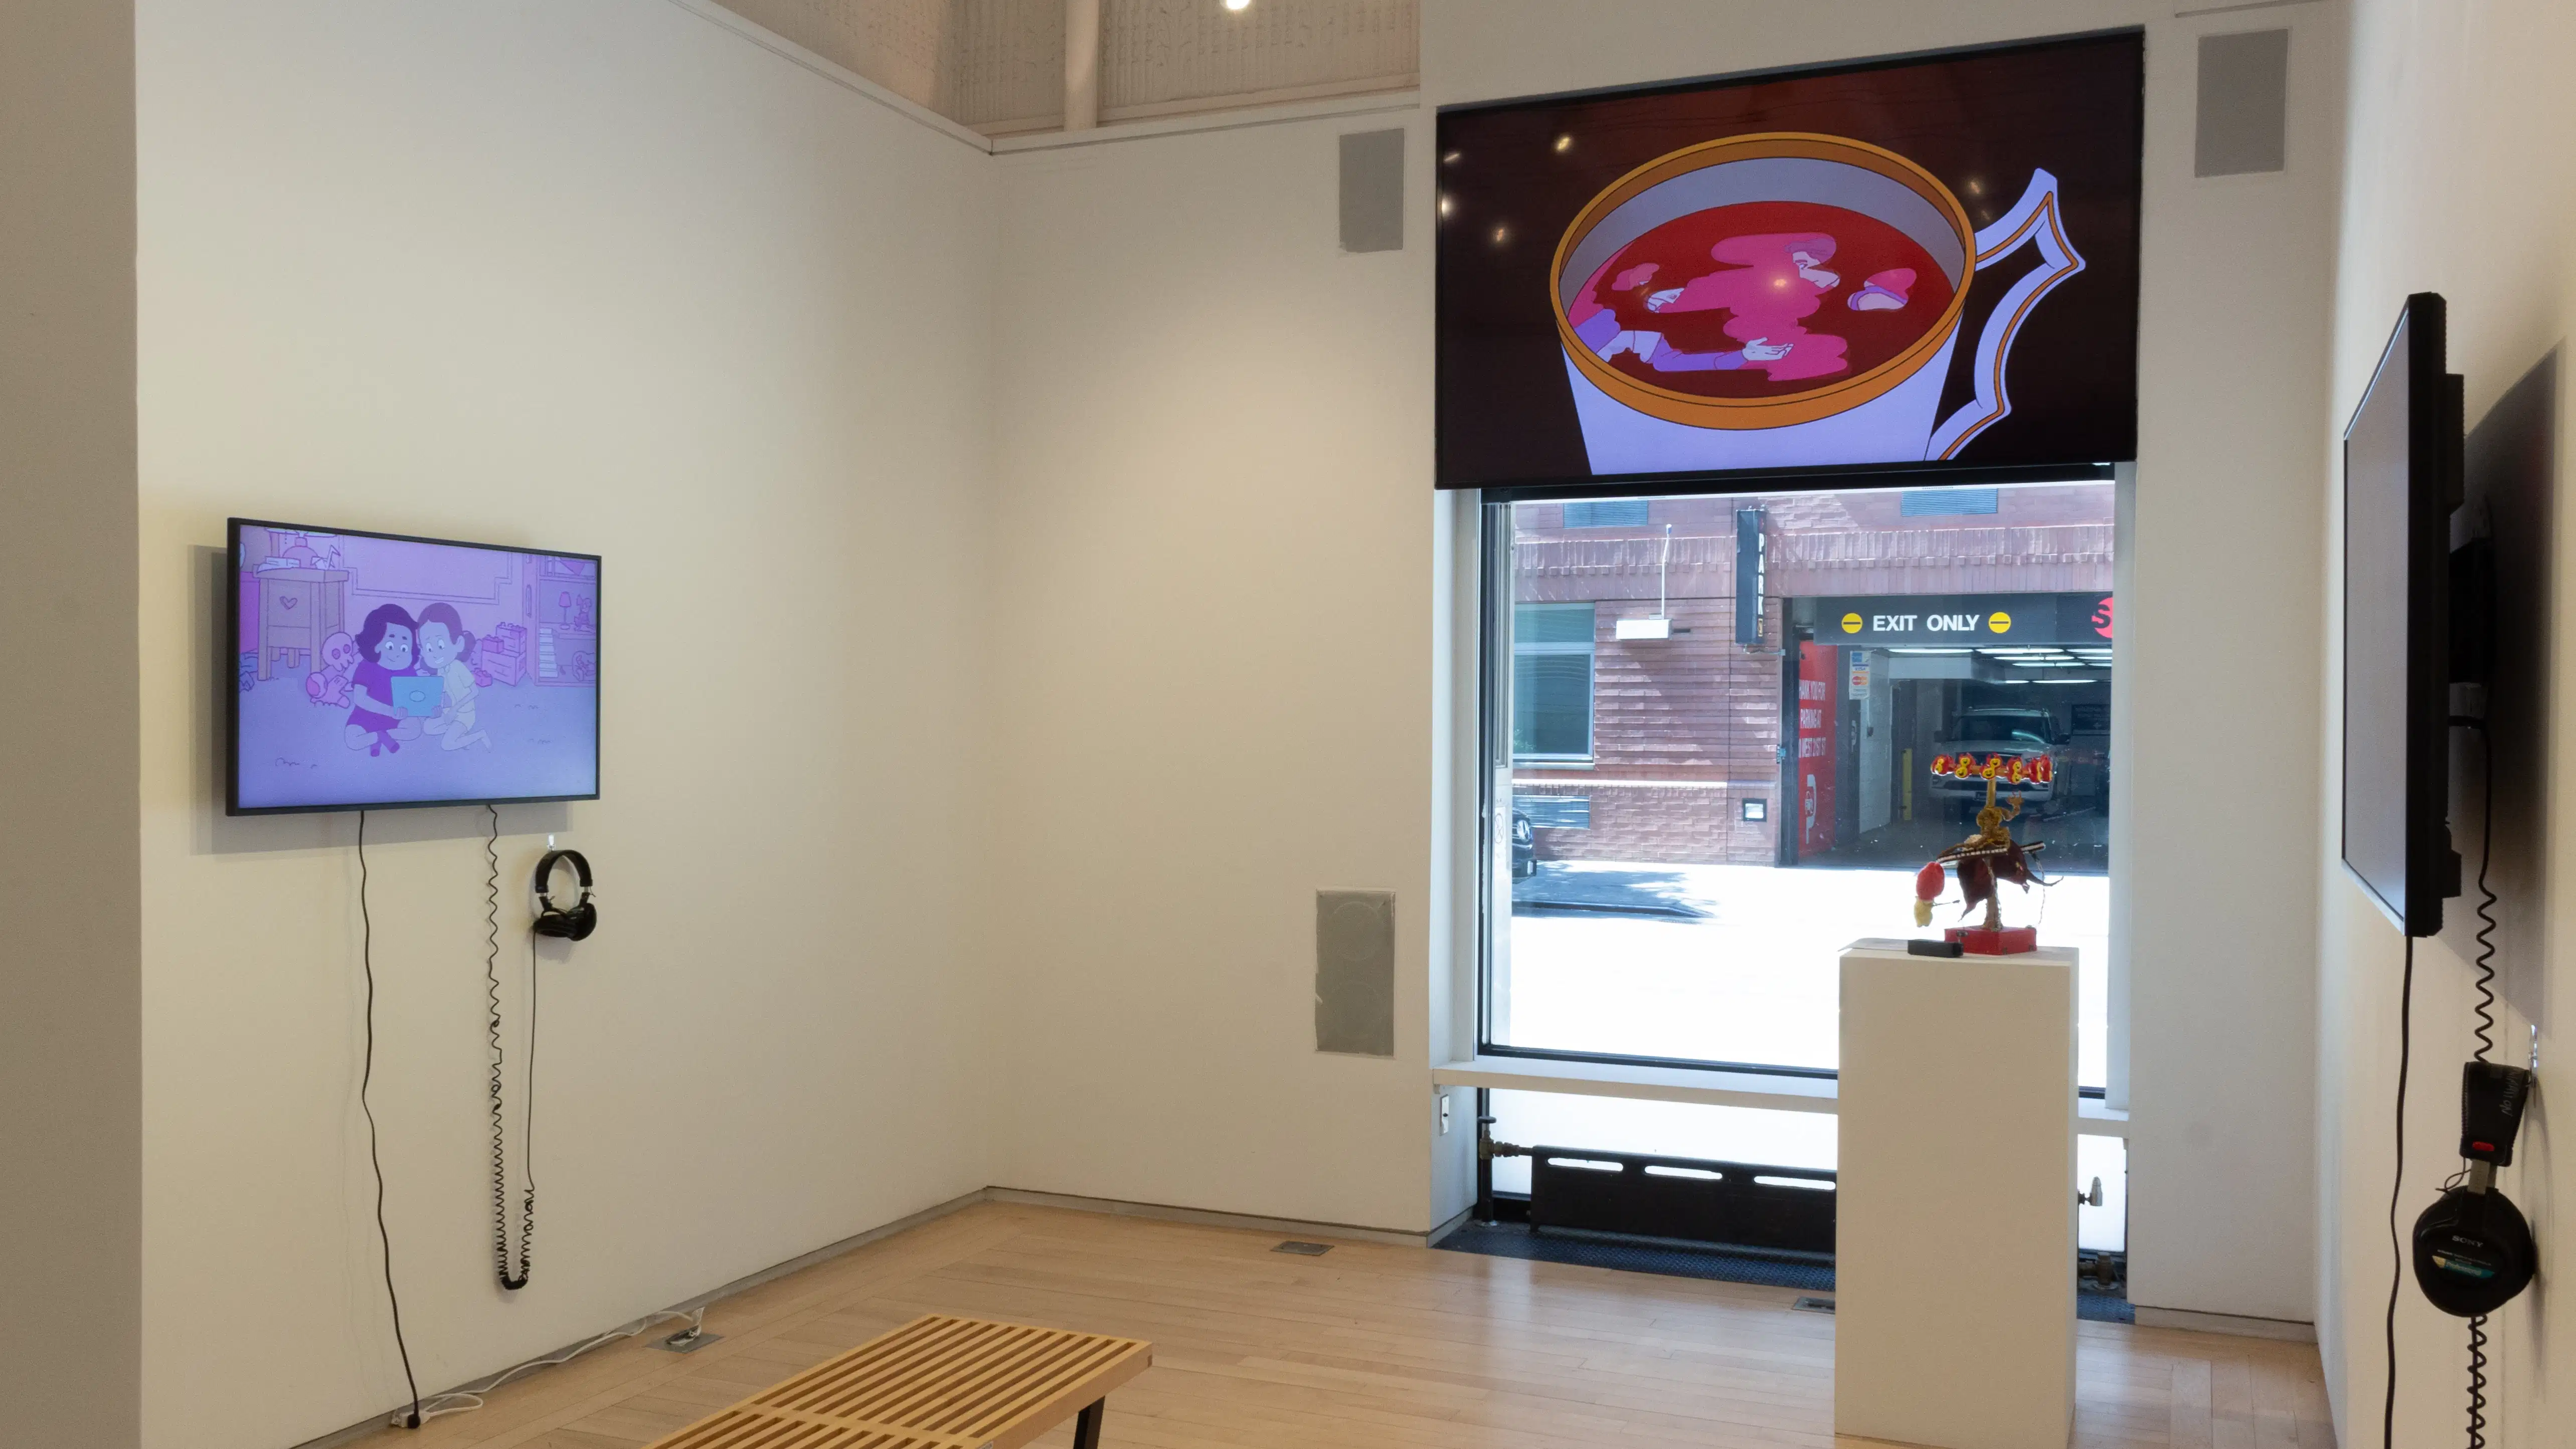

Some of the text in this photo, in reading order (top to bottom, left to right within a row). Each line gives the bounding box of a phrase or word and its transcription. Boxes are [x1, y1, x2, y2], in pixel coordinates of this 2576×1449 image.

[1873, 614, 1980, 631] EXIT ONLY
[1799, 679, 1809, 700] HANK
[2452, 1235, 2483, 1247] SONY
